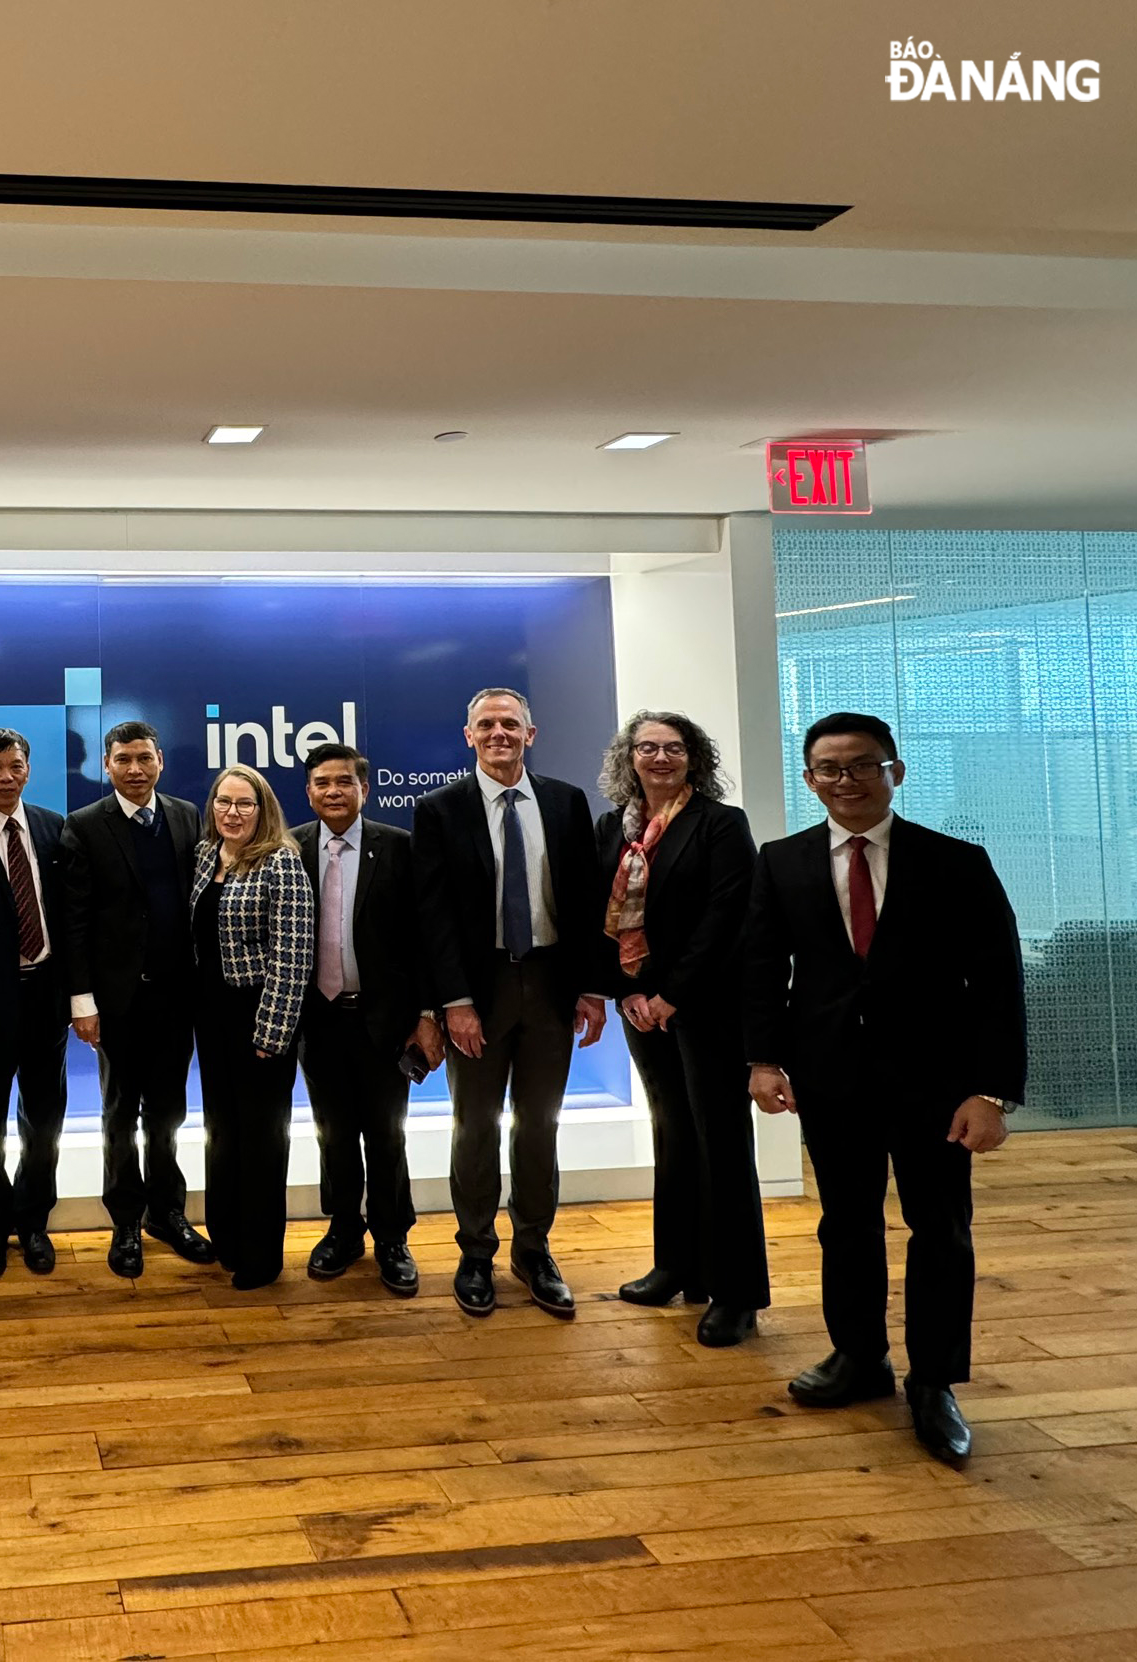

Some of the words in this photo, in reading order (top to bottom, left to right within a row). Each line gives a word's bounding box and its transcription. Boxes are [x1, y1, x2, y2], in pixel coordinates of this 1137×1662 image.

[787, 449, 855, 506] EXIT
[206, 701, 356, 768] intel
[377, 768, 404, 786] Do
